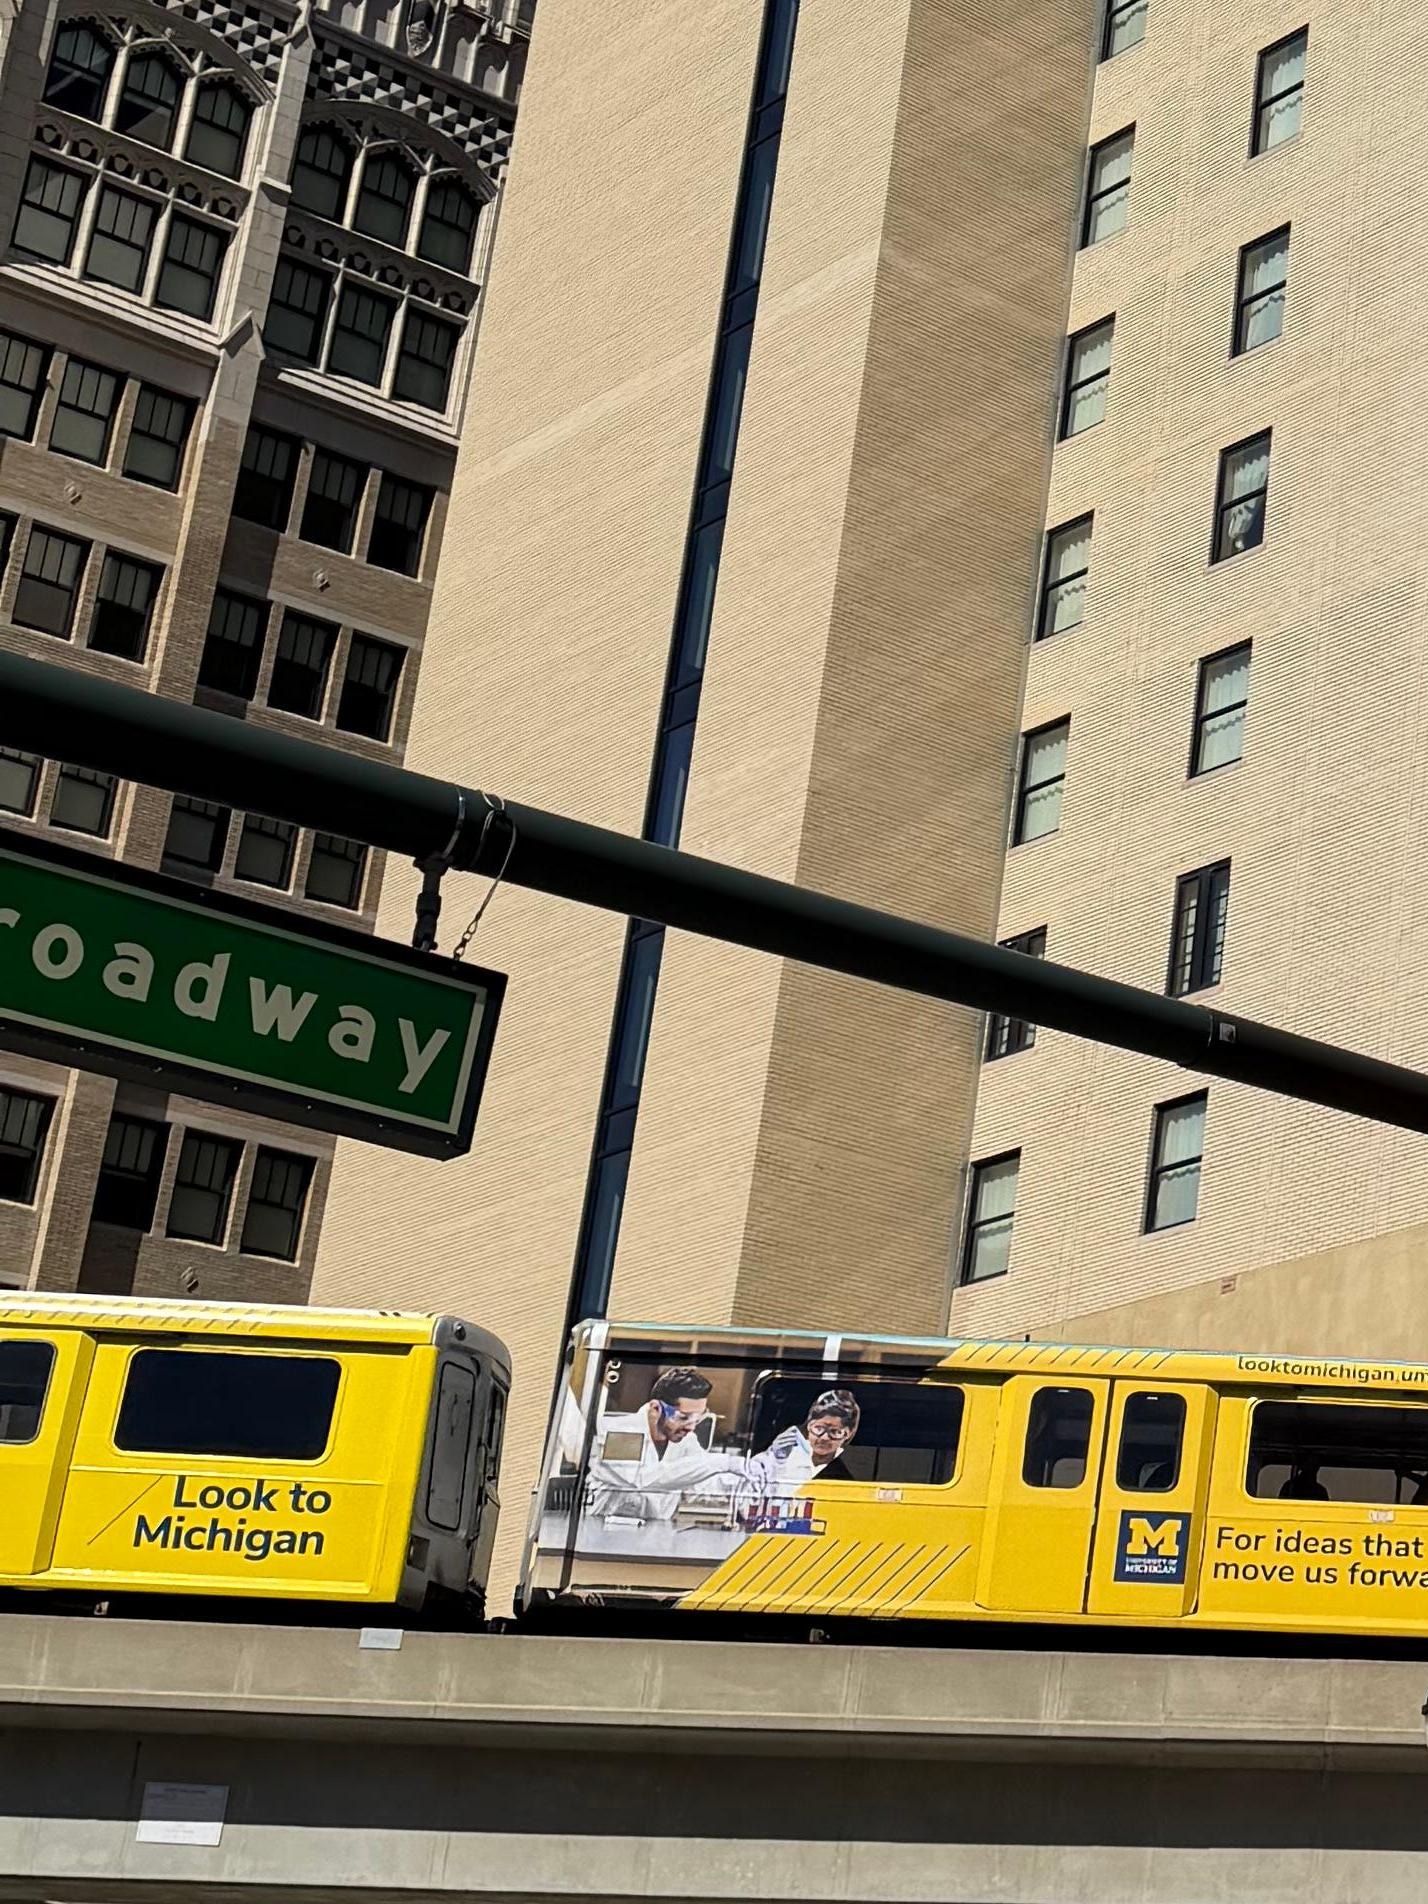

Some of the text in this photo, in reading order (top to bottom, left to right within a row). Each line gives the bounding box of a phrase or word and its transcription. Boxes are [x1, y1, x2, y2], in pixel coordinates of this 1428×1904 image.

[173, 1476, 332, 1516] Look to
[133, 1515, 324, 1562] Michigan
[1126, 1518, 1182, 1556] M
[1216, 1526, 1425, 1559] For ideas that
[1213, 1560, 1295, 1582] move
[1305, 1565, 1338, 1584] us
